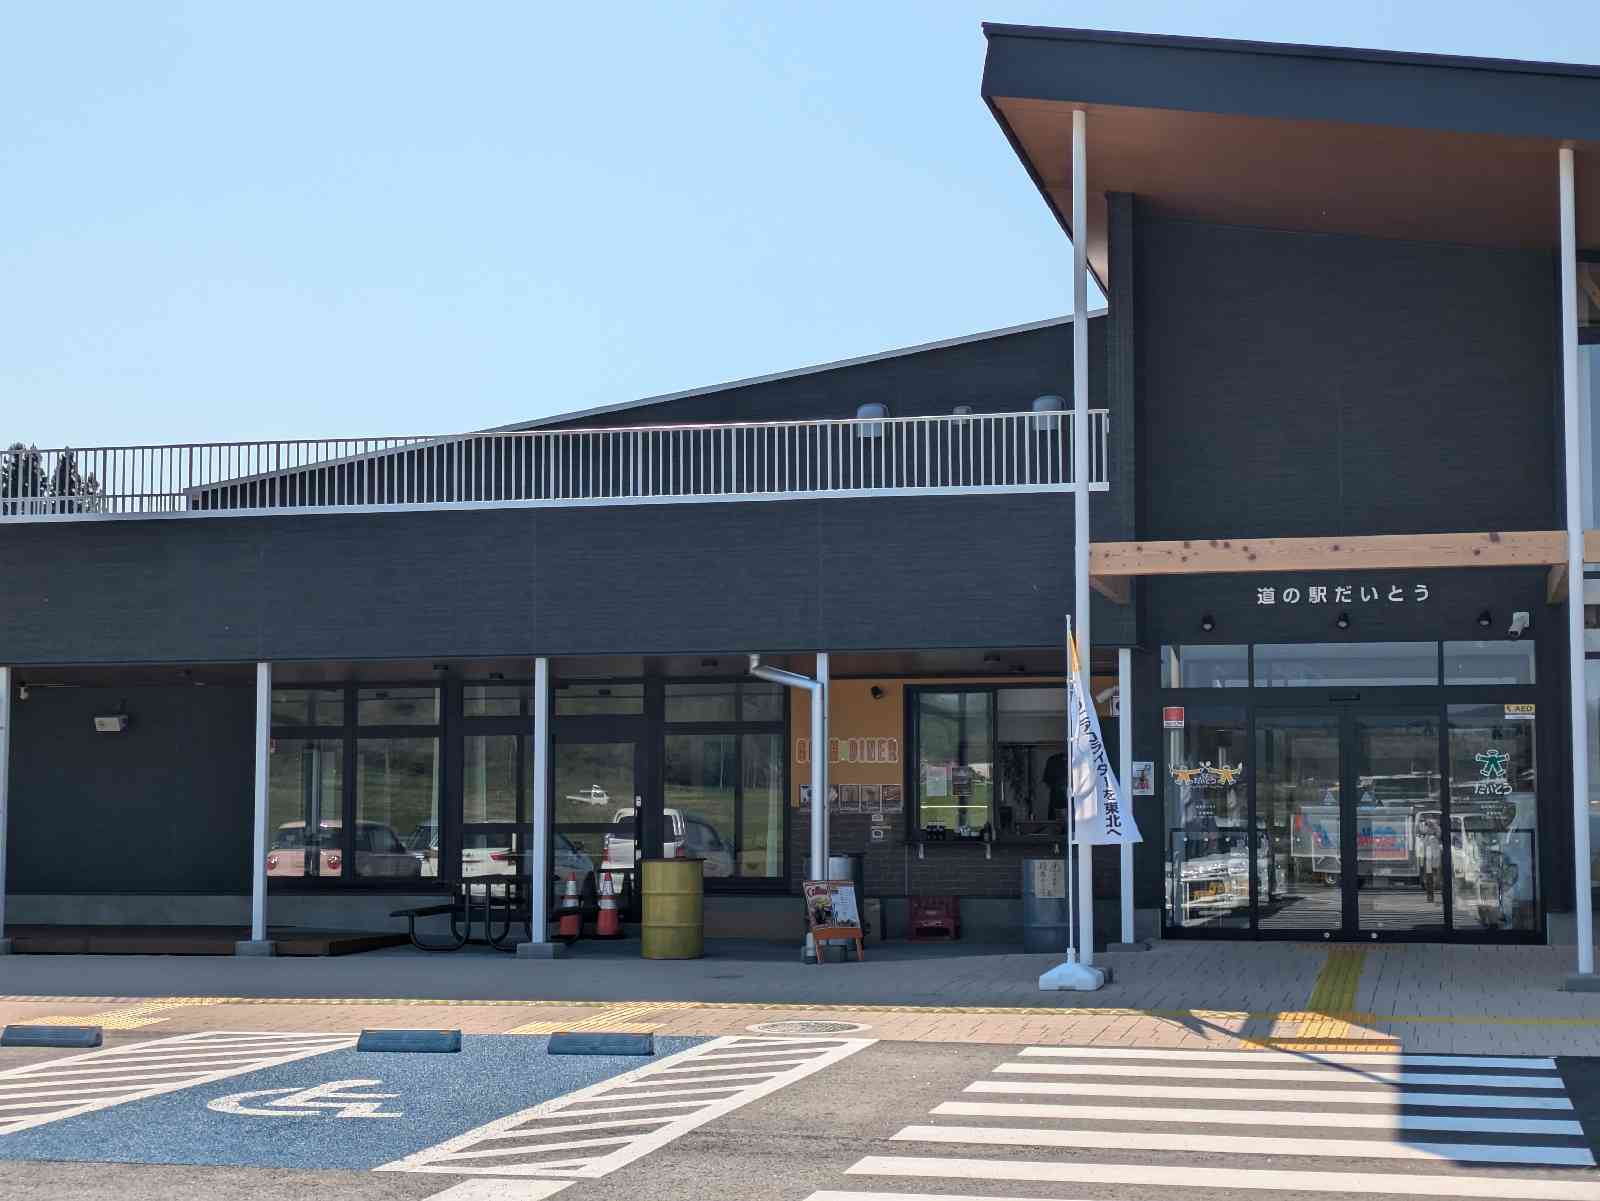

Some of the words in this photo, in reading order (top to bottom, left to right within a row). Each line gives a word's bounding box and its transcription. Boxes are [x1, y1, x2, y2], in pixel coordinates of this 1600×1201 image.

[1256, 584, 1430, 605] 道の駅だいとう
[847, 737, 898, 763] DINER
